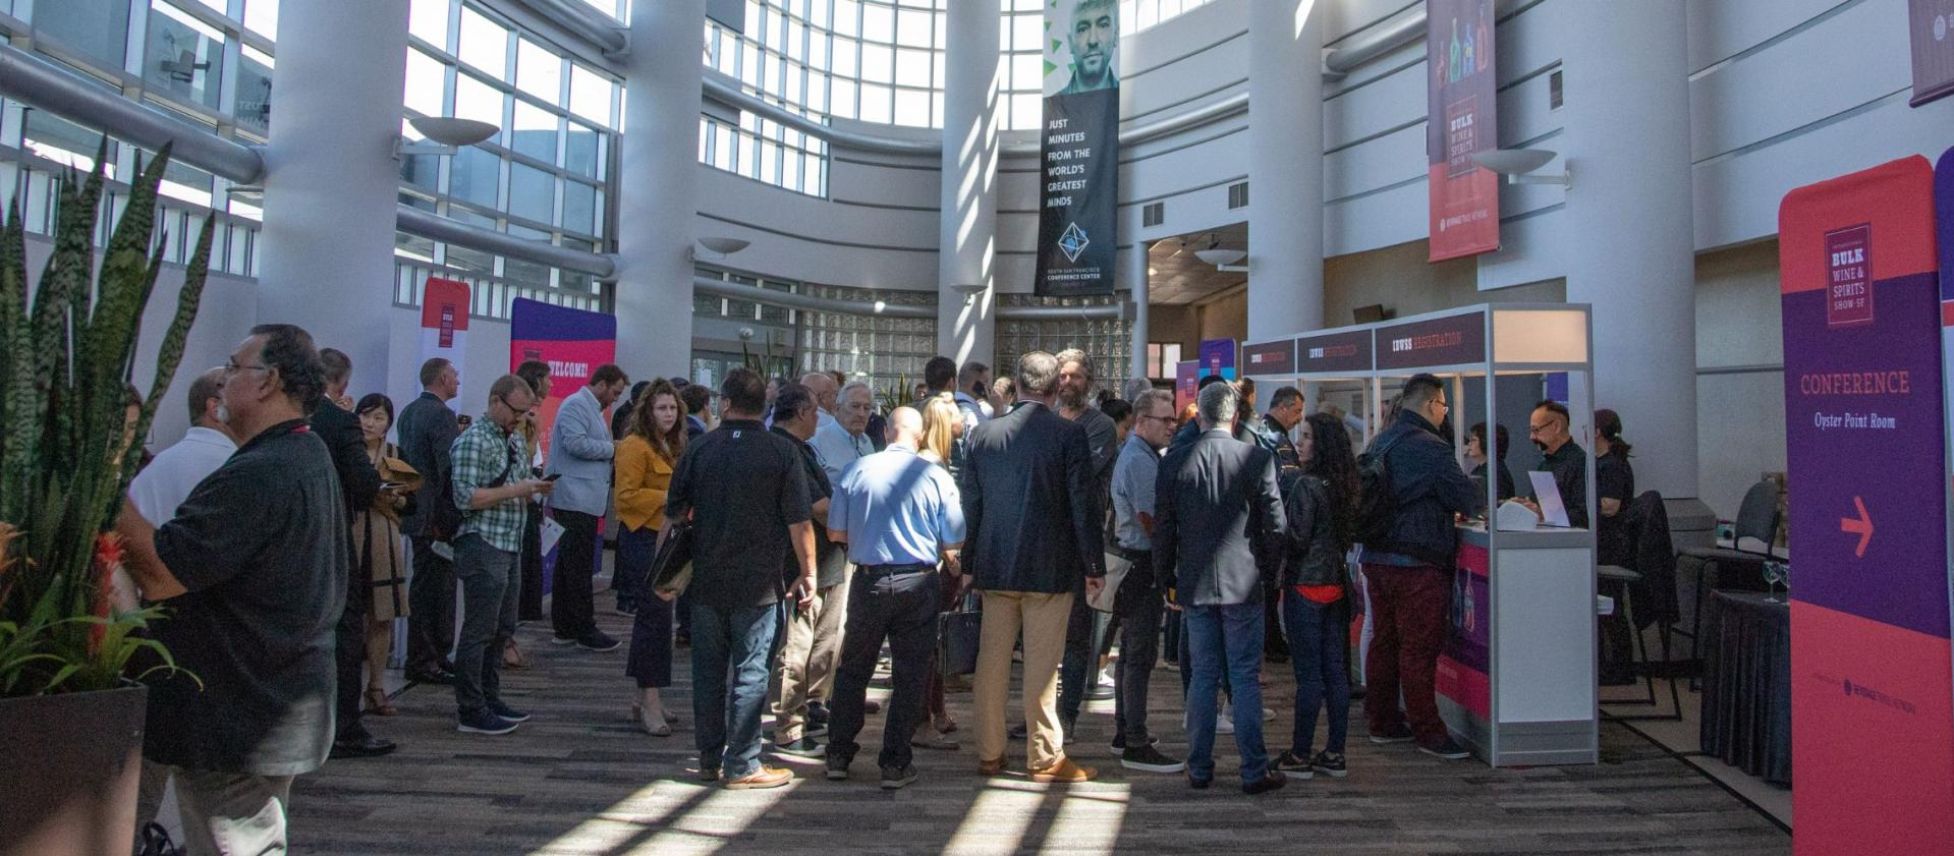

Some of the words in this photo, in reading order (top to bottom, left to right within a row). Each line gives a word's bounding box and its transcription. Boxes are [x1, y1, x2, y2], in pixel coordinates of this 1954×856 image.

[1049, 119, 1068, 129] JUST
[1451, 114, 1472, 132] BULK
[1049, 132, 1085, 144] MINUTES
[1048, 150, 1071, 161] FROM
[1074, 148, 1090, 159] THE
[1048, 164, 1085, 176] WORLD'S
[1048, 180, 1087, 192] GREATEST
[1047, 196, 1072, 207] MINDS
[1832, 248, 1865, 267] BULK
[1833, 267, 1857, 282] WINE
[1857, 266, 1865, 278] &
[1834, 282, 1865, 298] SPIRITS
[1834, 299, 1853, 311] SHOW
[1800, 371, 1910, 395] CONFERENCE
[1814, 412, 1842, 431] Oyster
[1845, 412, 1868, 428] Point
[1870, 413, 1896, 429] Room
